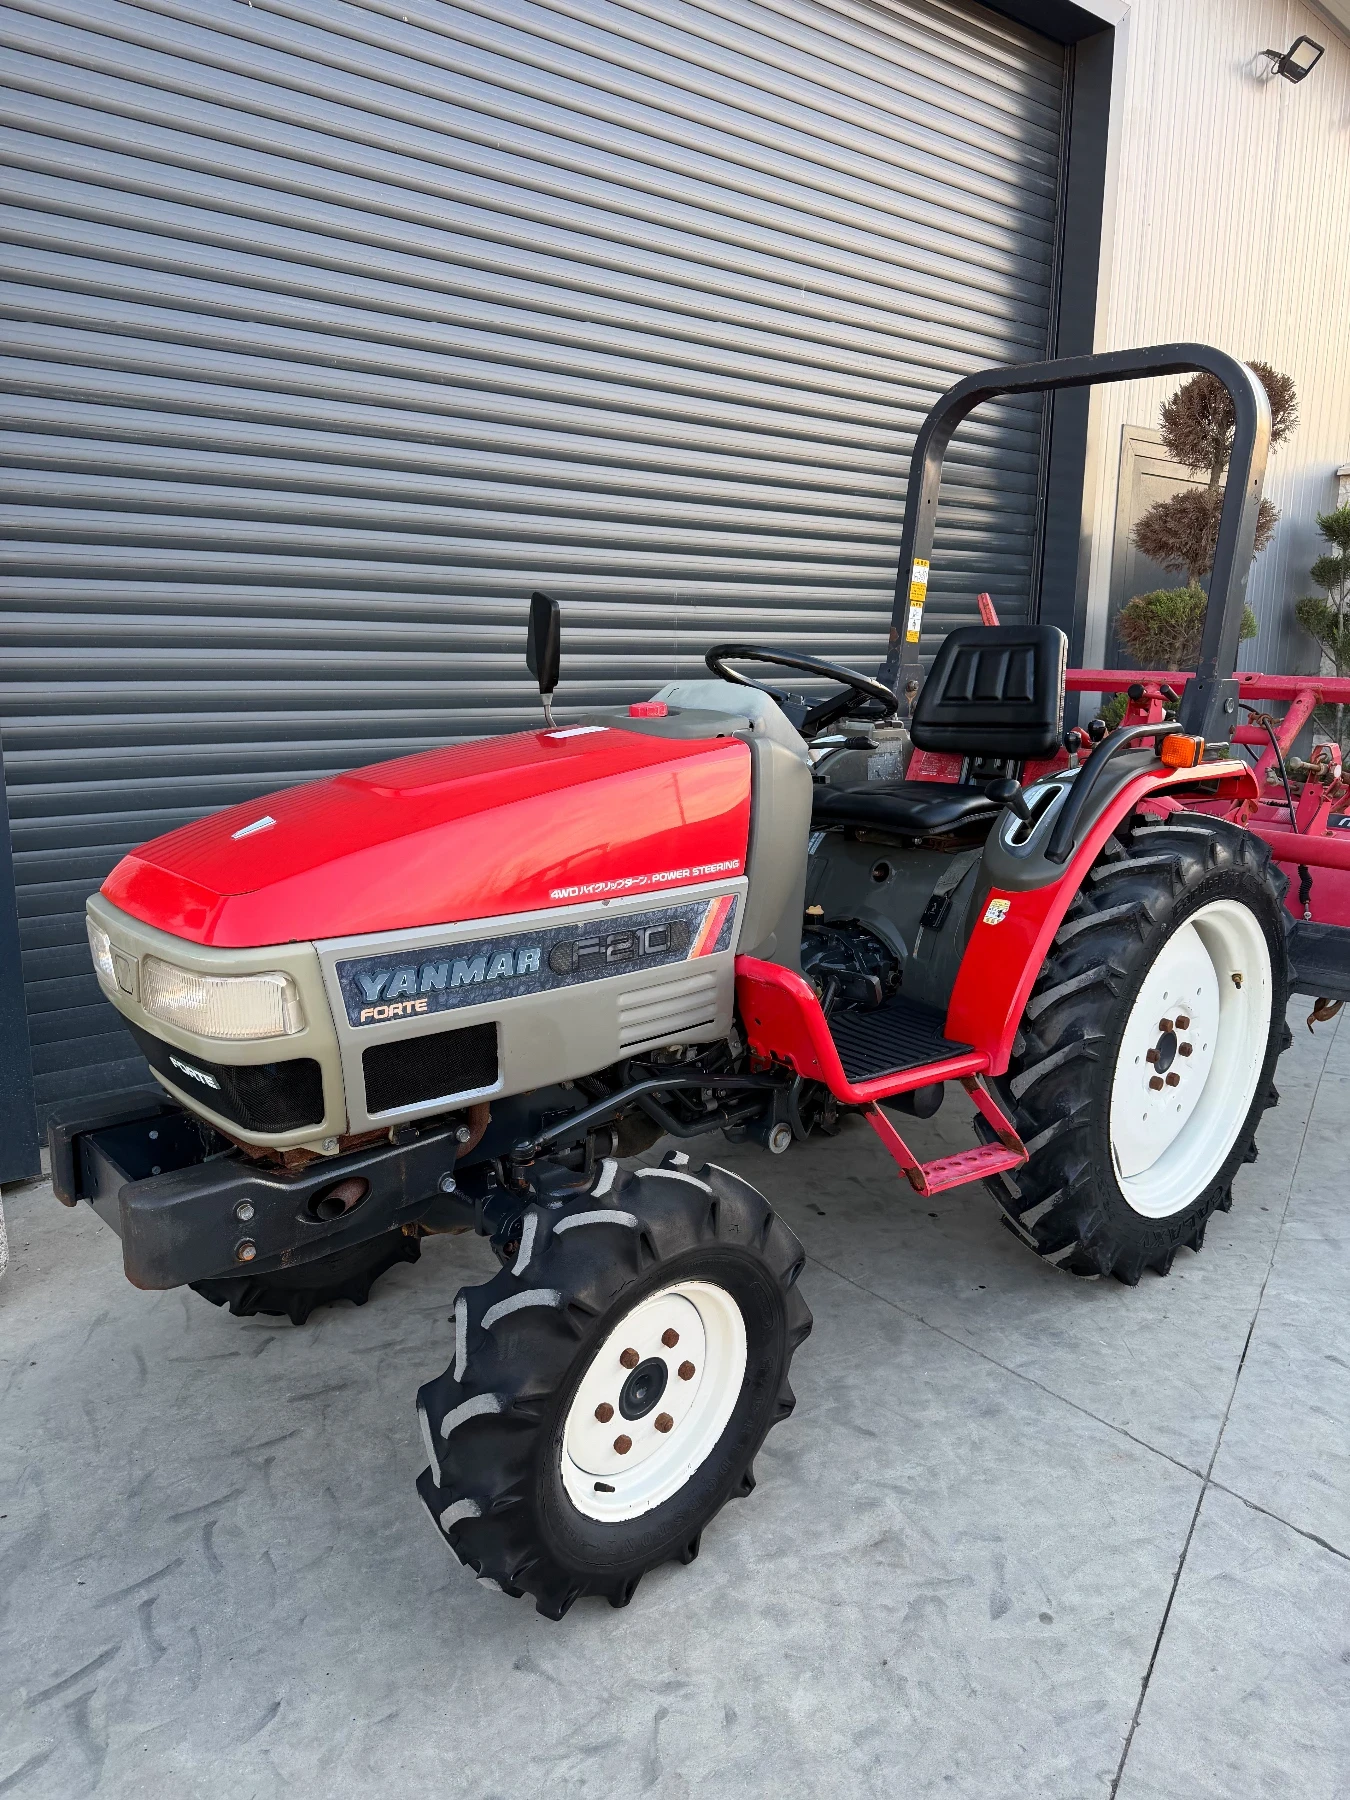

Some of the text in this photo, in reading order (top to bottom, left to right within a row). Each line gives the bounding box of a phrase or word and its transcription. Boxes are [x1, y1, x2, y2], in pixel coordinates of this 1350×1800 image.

[550, 887, 578, 899] 4WD
[652, 869, 690, 883] POWER
[692, 859, 740, 876] STEERING
[355, 946, 541, 1003] YANMAR
[360, 998, 428, 1023] FORTE
[169, 1056, 218, 1090] FORTE
